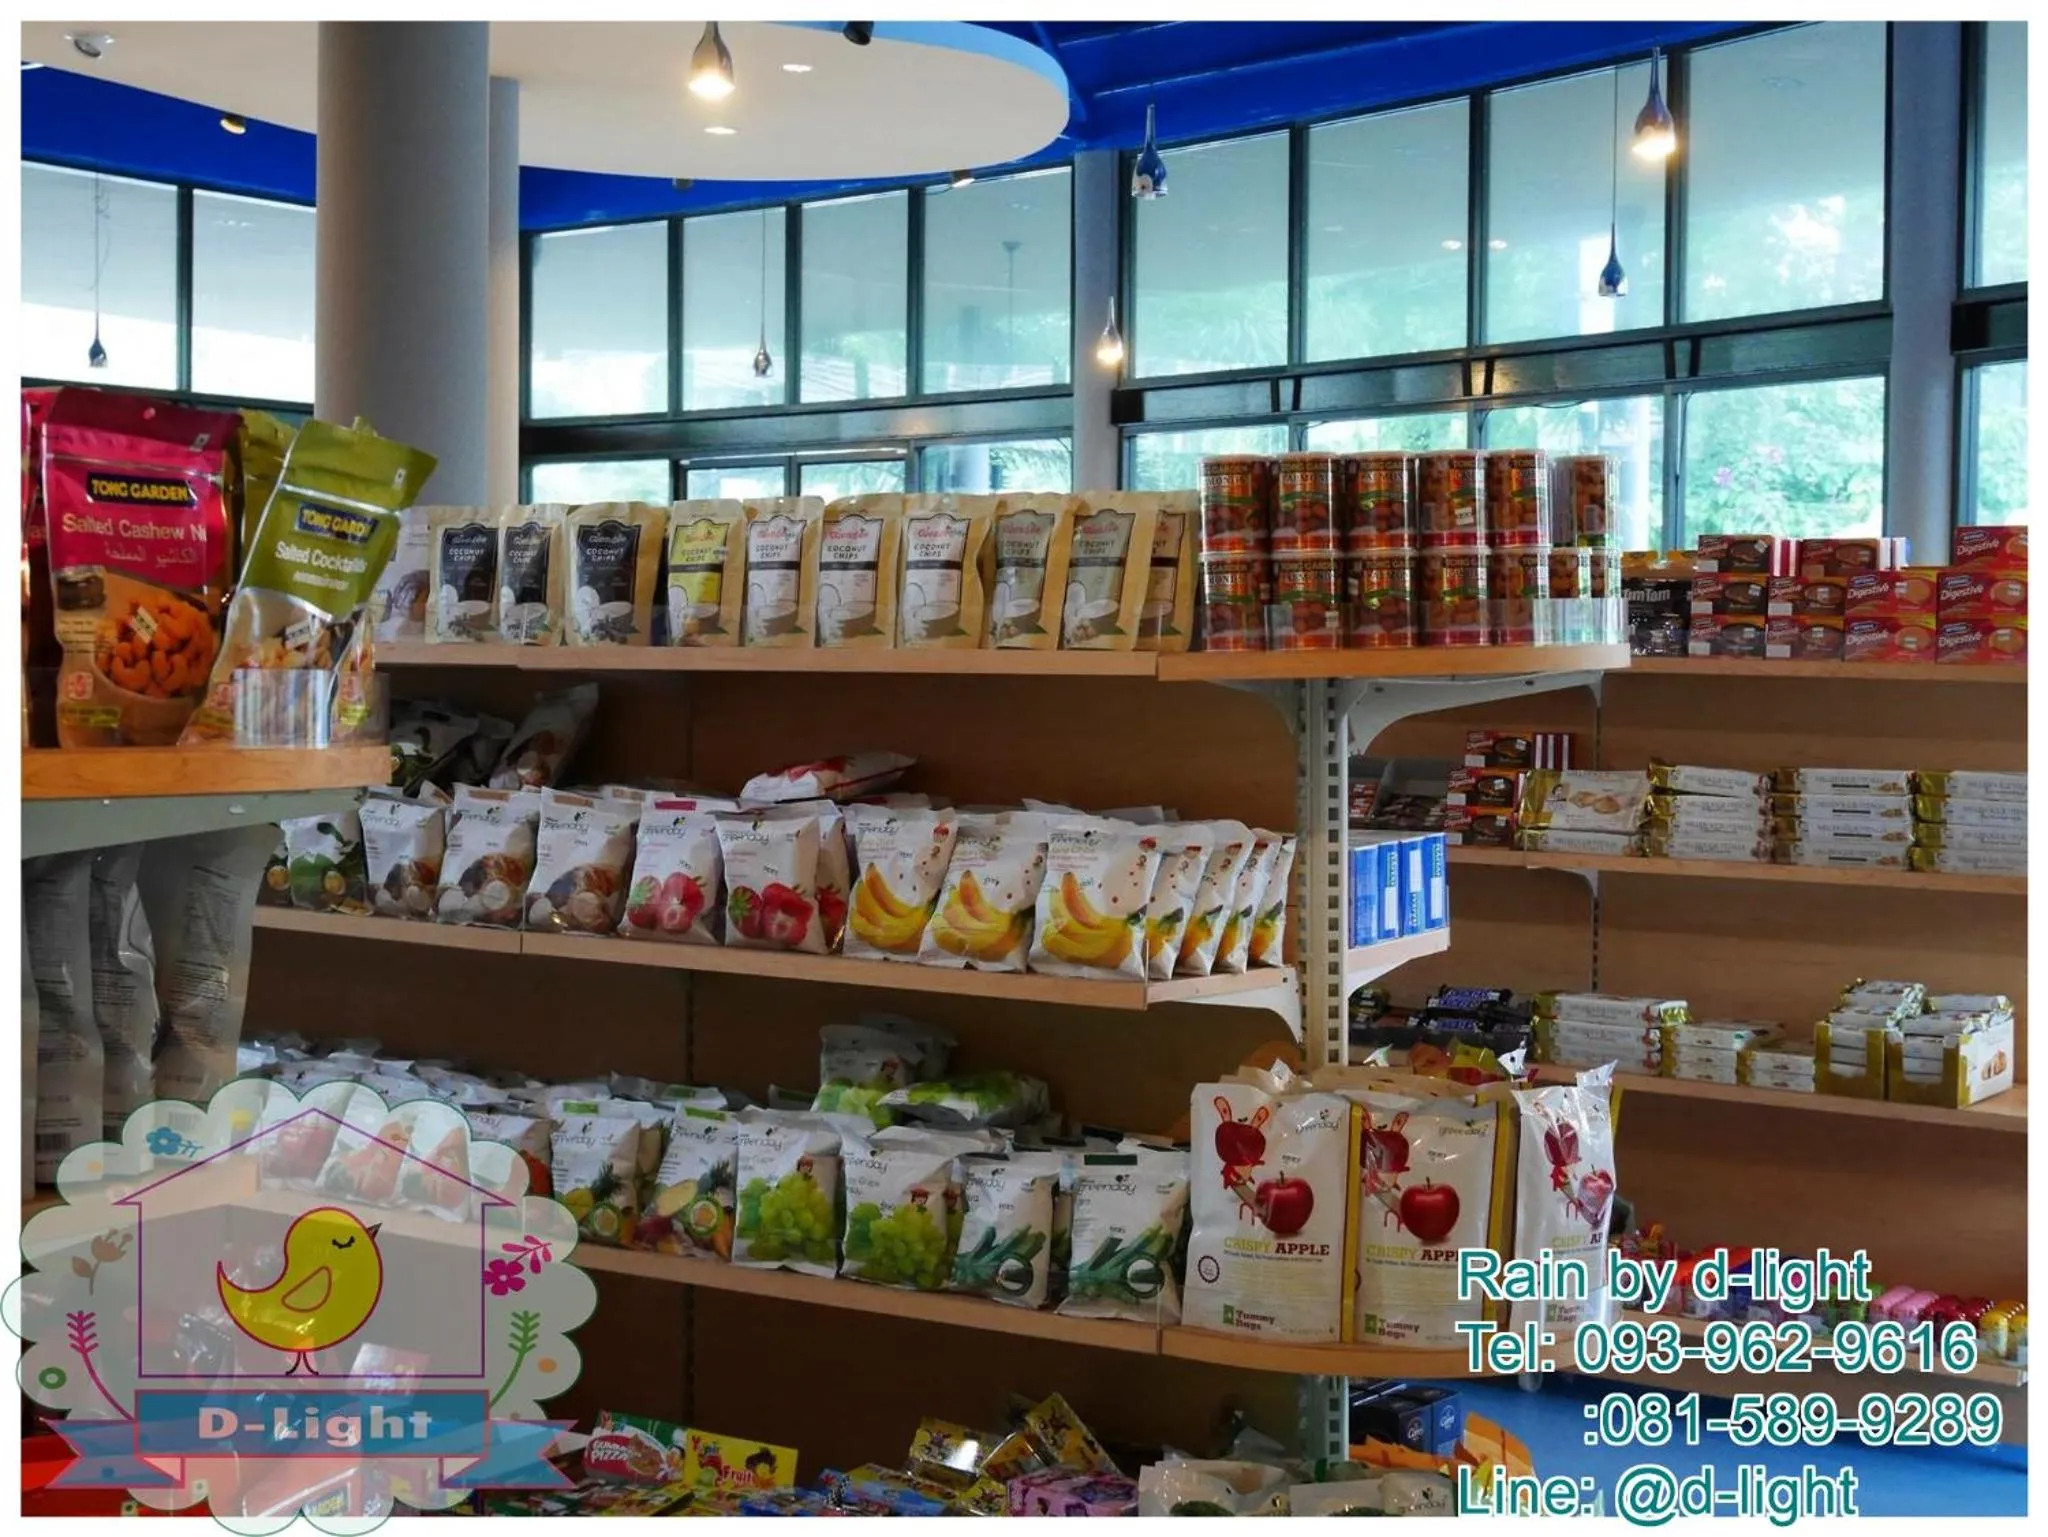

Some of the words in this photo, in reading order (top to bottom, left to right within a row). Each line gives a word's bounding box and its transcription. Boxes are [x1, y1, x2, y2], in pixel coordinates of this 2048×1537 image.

[91, 479, 128, 498] TONG
[129, 482, 188, 501] GARDEN
[61, 512, 114, 537] Salted
[118, 519, 185, 540] Cashew
[1956, 539, 2000, 556] Digestive
[1846, 583, 1890, 599] Digestive
[1939, 584, 1984, 601] Digestive
[1938, 631, 1983, 648] Digestive
[1078, 1179, 1138, 1198] greenday
[1274, 1242, 1331, 1257] APPLE
[1235, 1309, 1276, 1325] Tummy
[1378, 1318, 1421, 1334] Tummy
